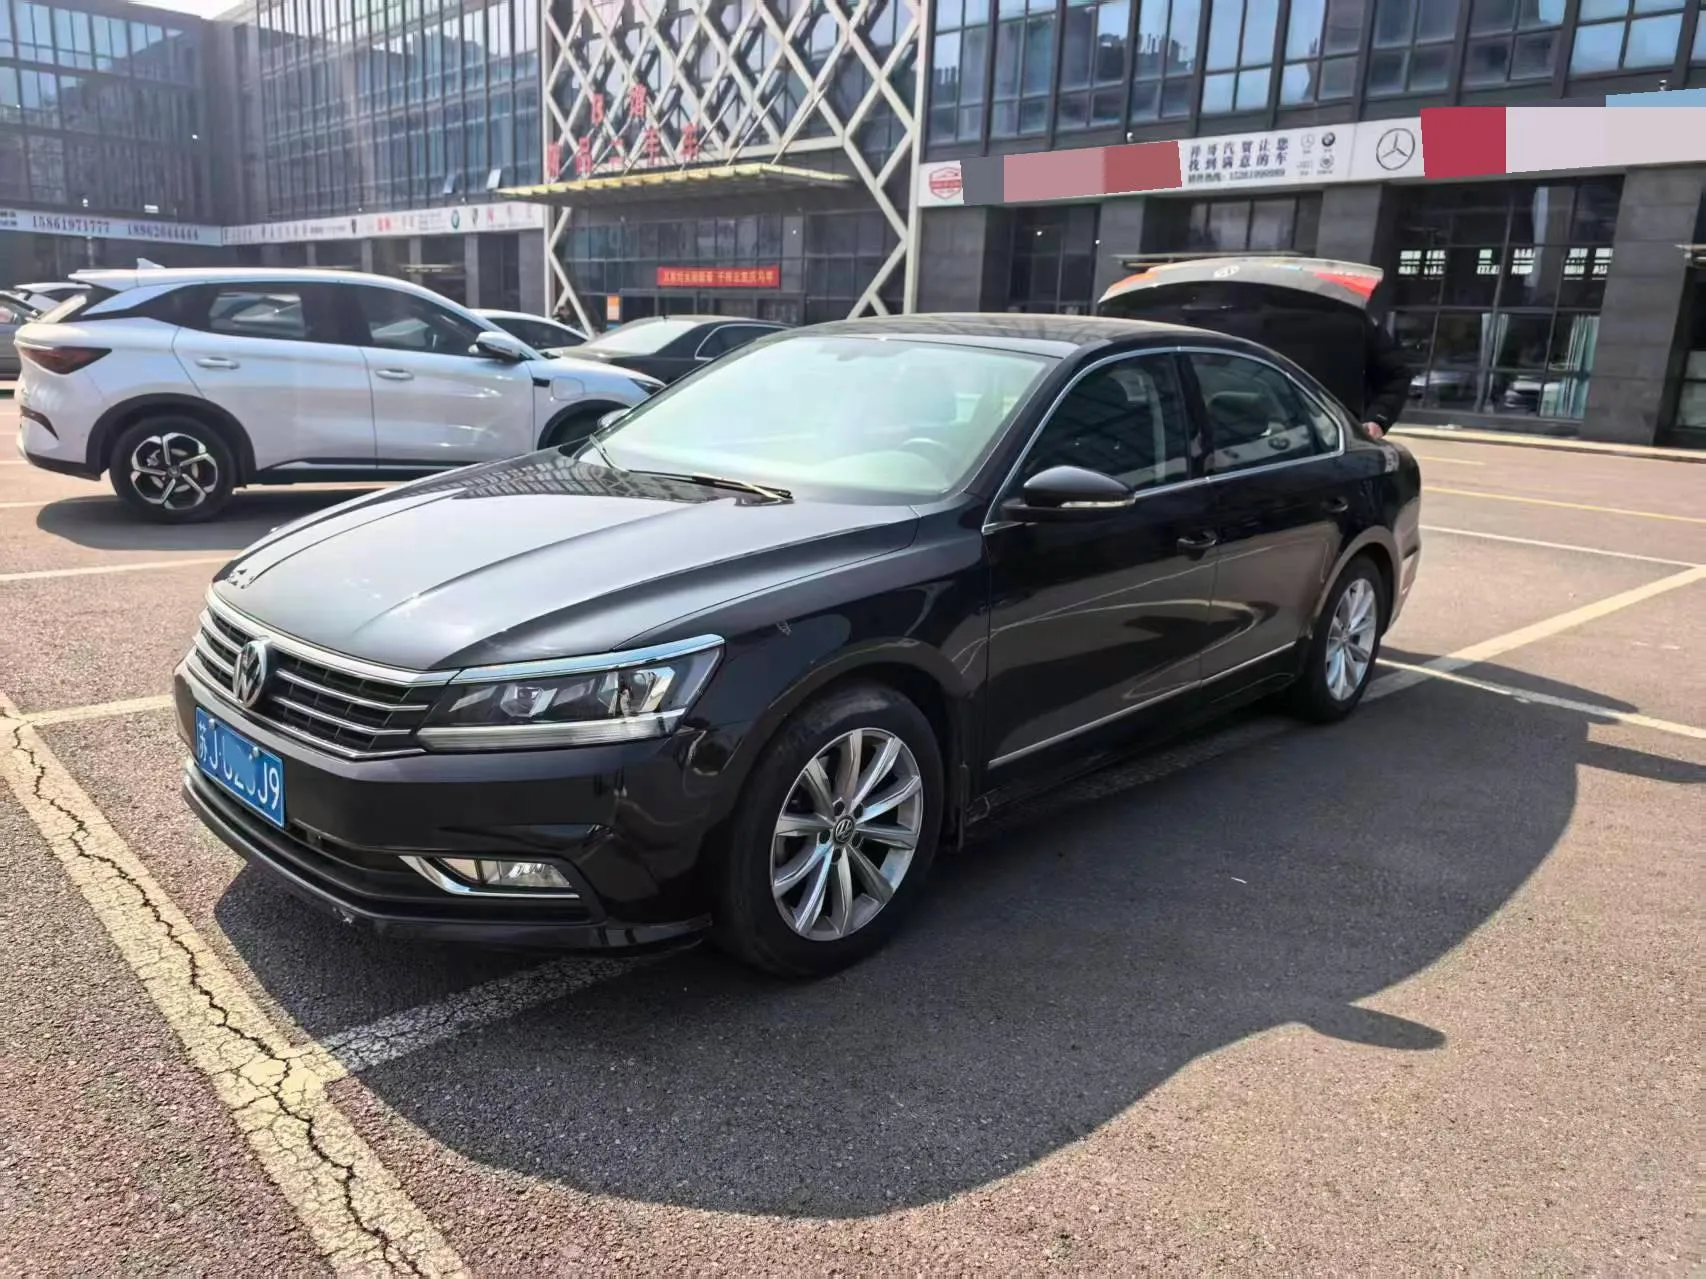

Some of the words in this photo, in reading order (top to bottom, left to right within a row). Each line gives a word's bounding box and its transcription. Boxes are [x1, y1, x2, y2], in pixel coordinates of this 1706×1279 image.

[1188, 152, 1288, 172] 找到满意的车
[32, 214, 110, 234] 15861971777
